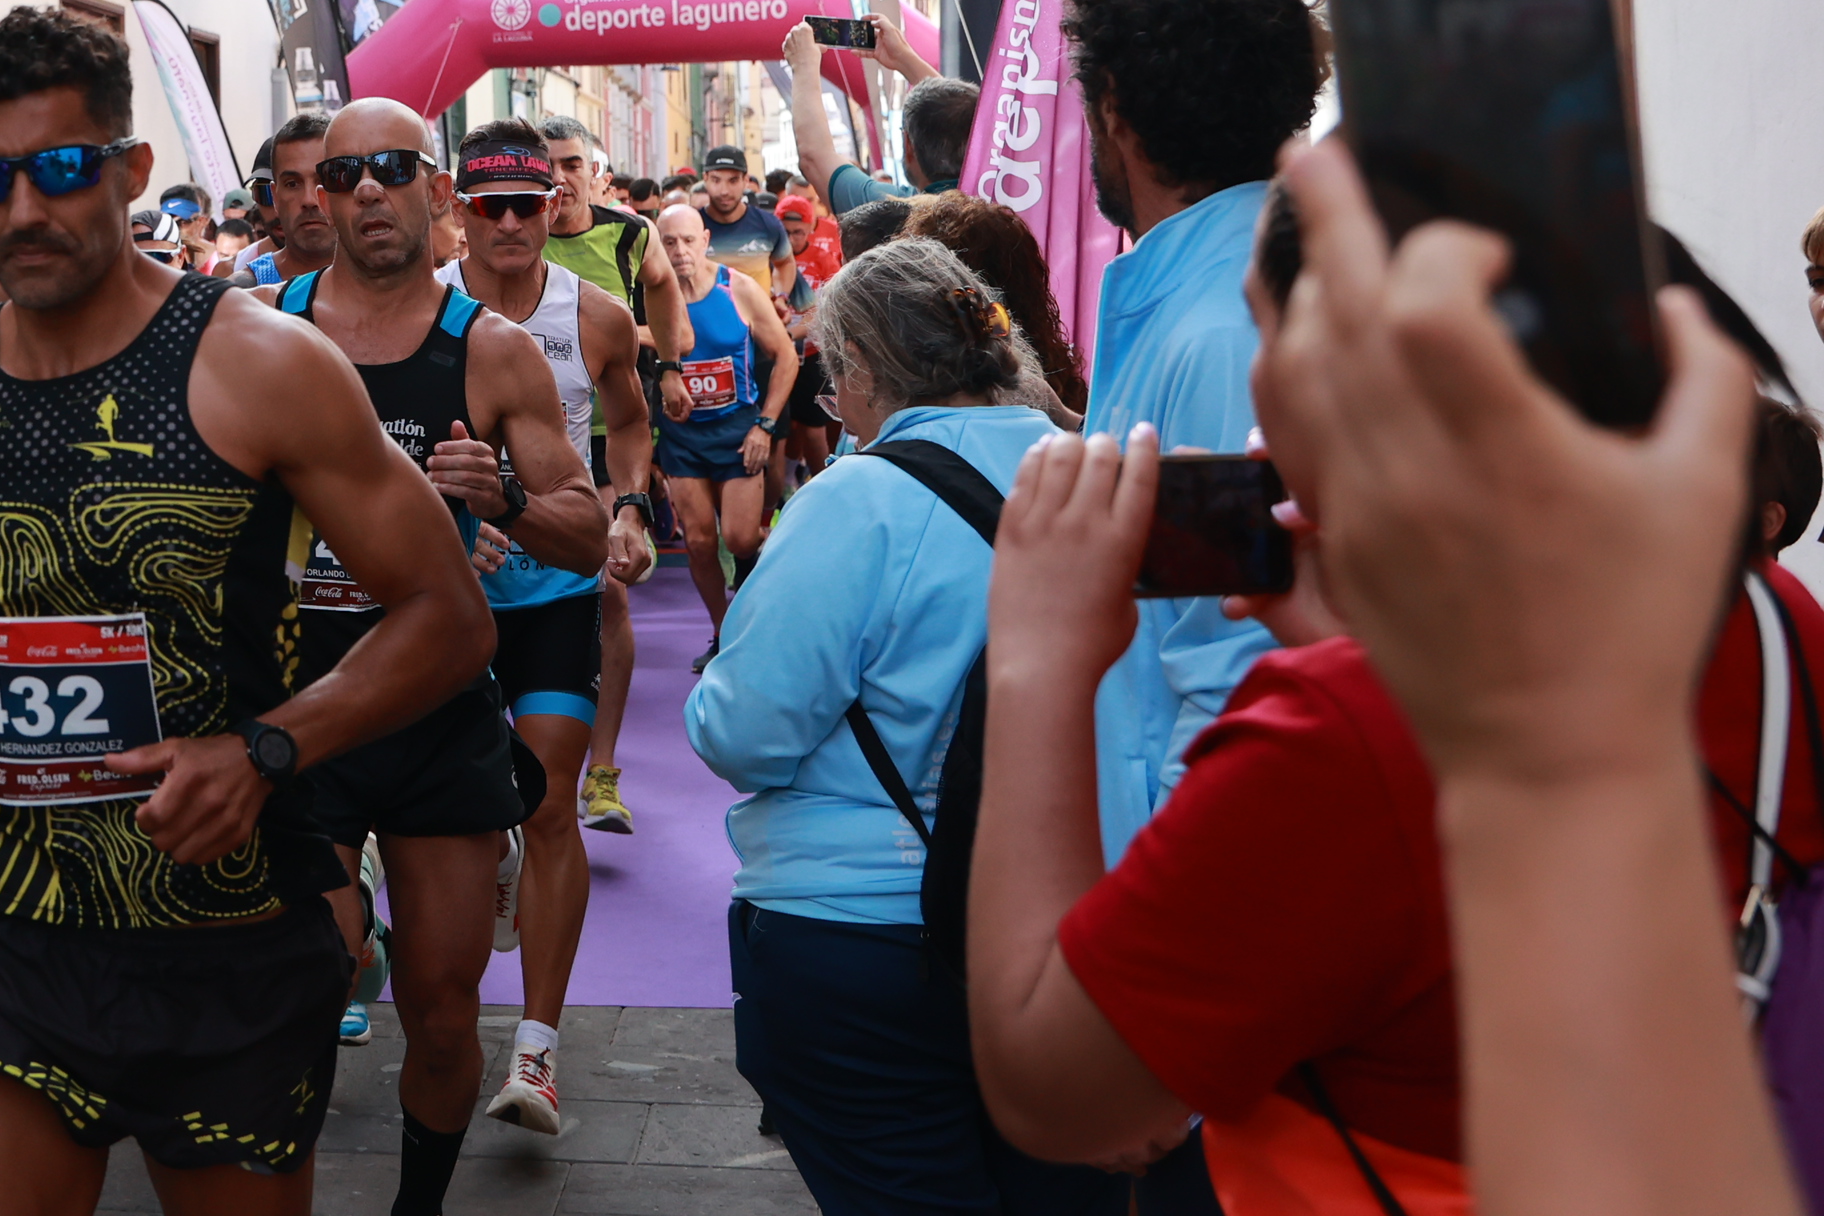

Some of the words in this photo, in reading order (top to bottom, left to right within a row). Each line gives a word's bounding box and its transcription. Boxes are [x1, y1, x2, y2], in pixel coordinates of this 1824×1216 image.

[564, 2, 665, 36] deporte
[467, 155, 517, 172] OCEAN
[688, 375, 718, 394] 90
[306, 568, 345, 578] ORLANDO
[0, 741, 62, 755] HERNANDEZ
[64, 739, 124, 754] GONZALEZ
